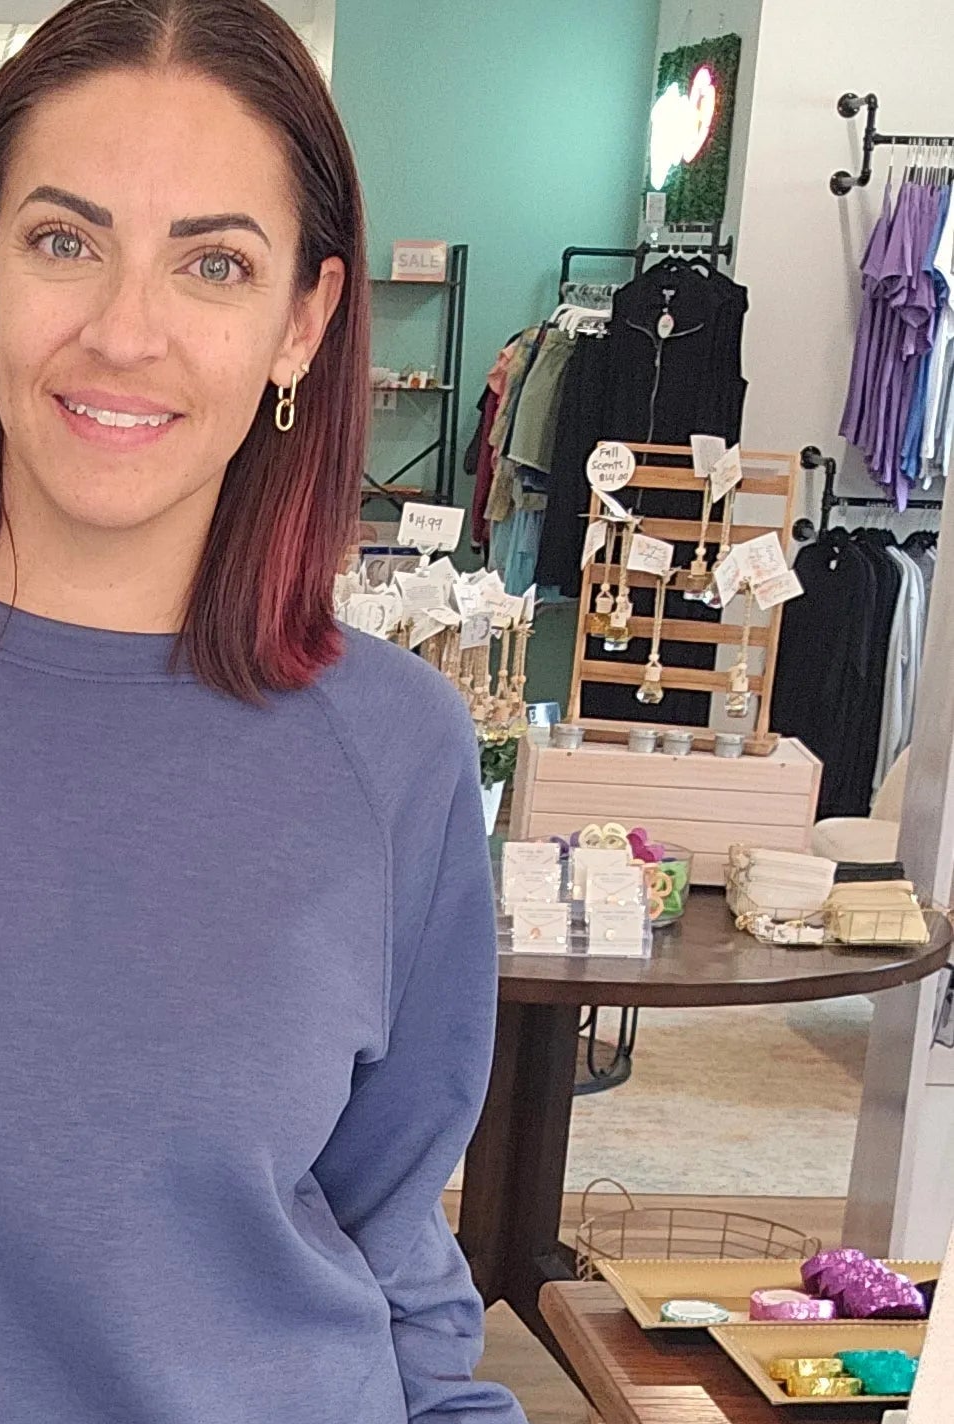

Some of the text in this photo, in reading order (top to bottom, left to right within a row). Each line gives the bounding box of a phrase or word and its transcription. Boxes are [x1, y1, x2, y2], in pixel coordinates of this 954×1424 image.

[398, 254, 439, 268] SALE
[599, 446, 619, 458] Fall
[408, 512, 443, 531] $14.99
